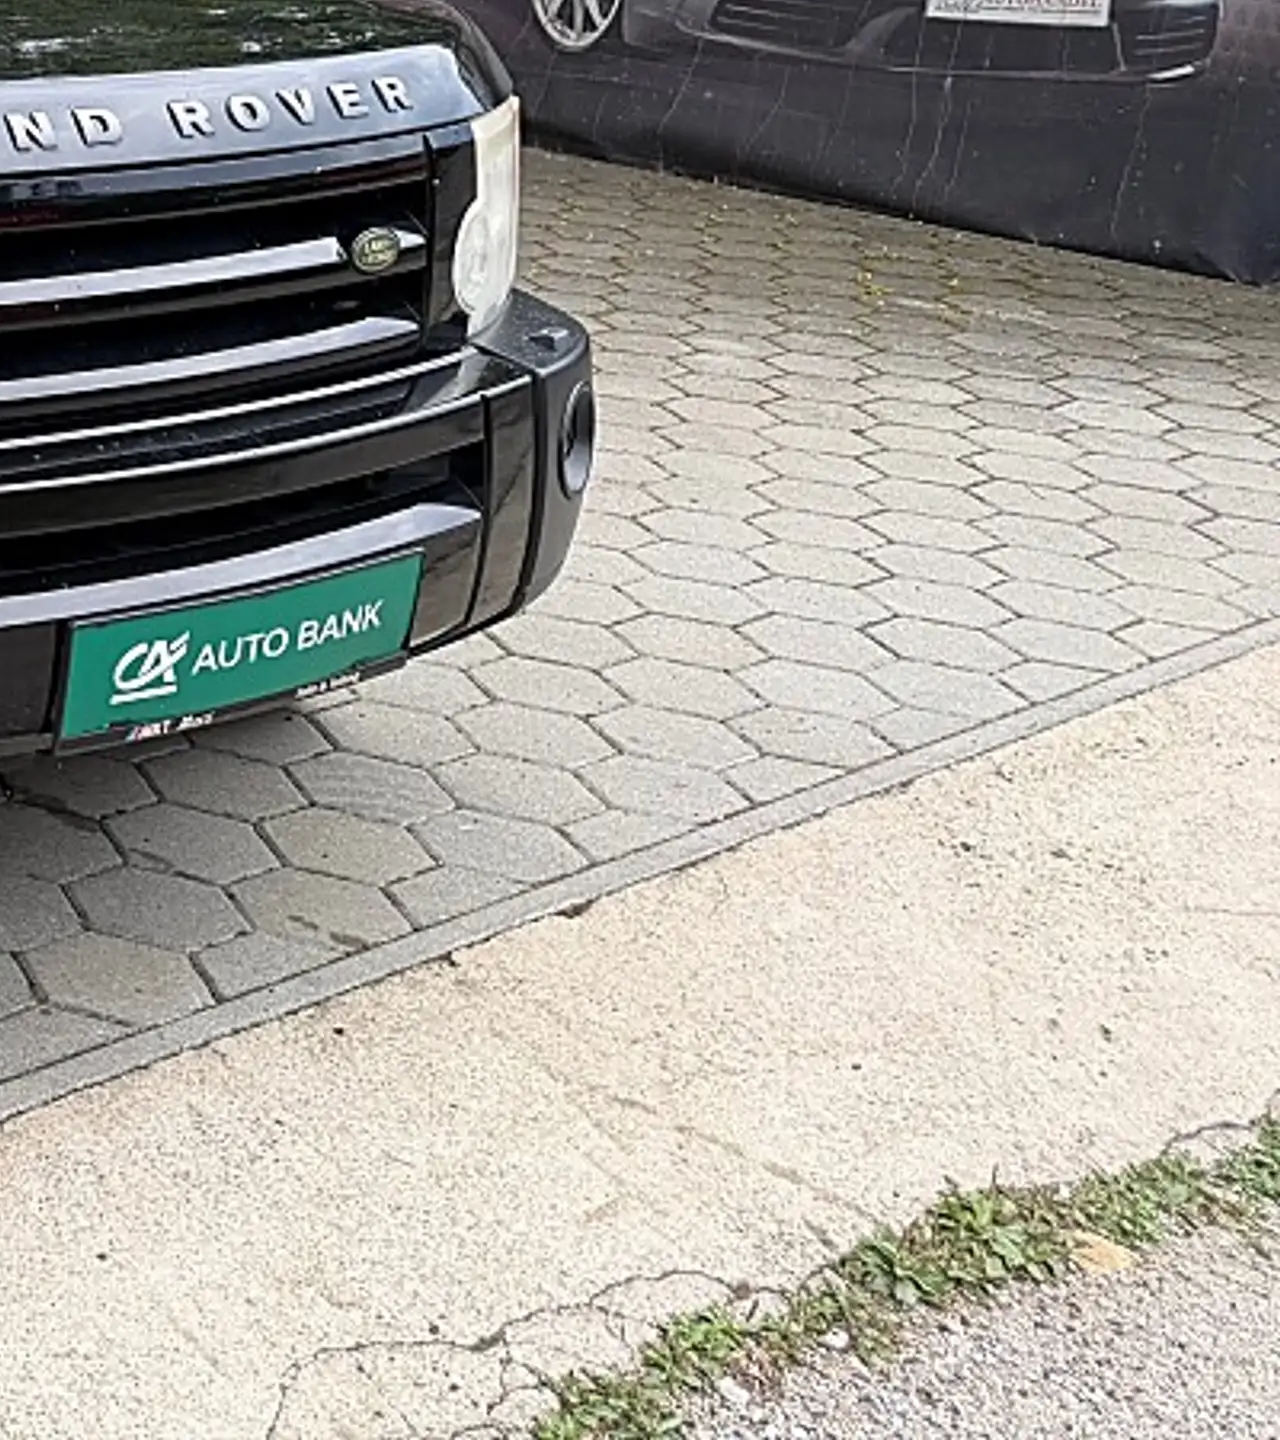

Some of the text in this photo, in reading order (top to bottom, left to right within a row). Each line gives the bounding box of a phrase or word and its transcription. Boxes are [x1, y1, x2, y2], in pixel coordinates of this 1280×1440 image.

[166, 75, 414, 140] ROVER
[191, 626, 290, 677] AUTO
[296, 599, 385, 652] BANK
